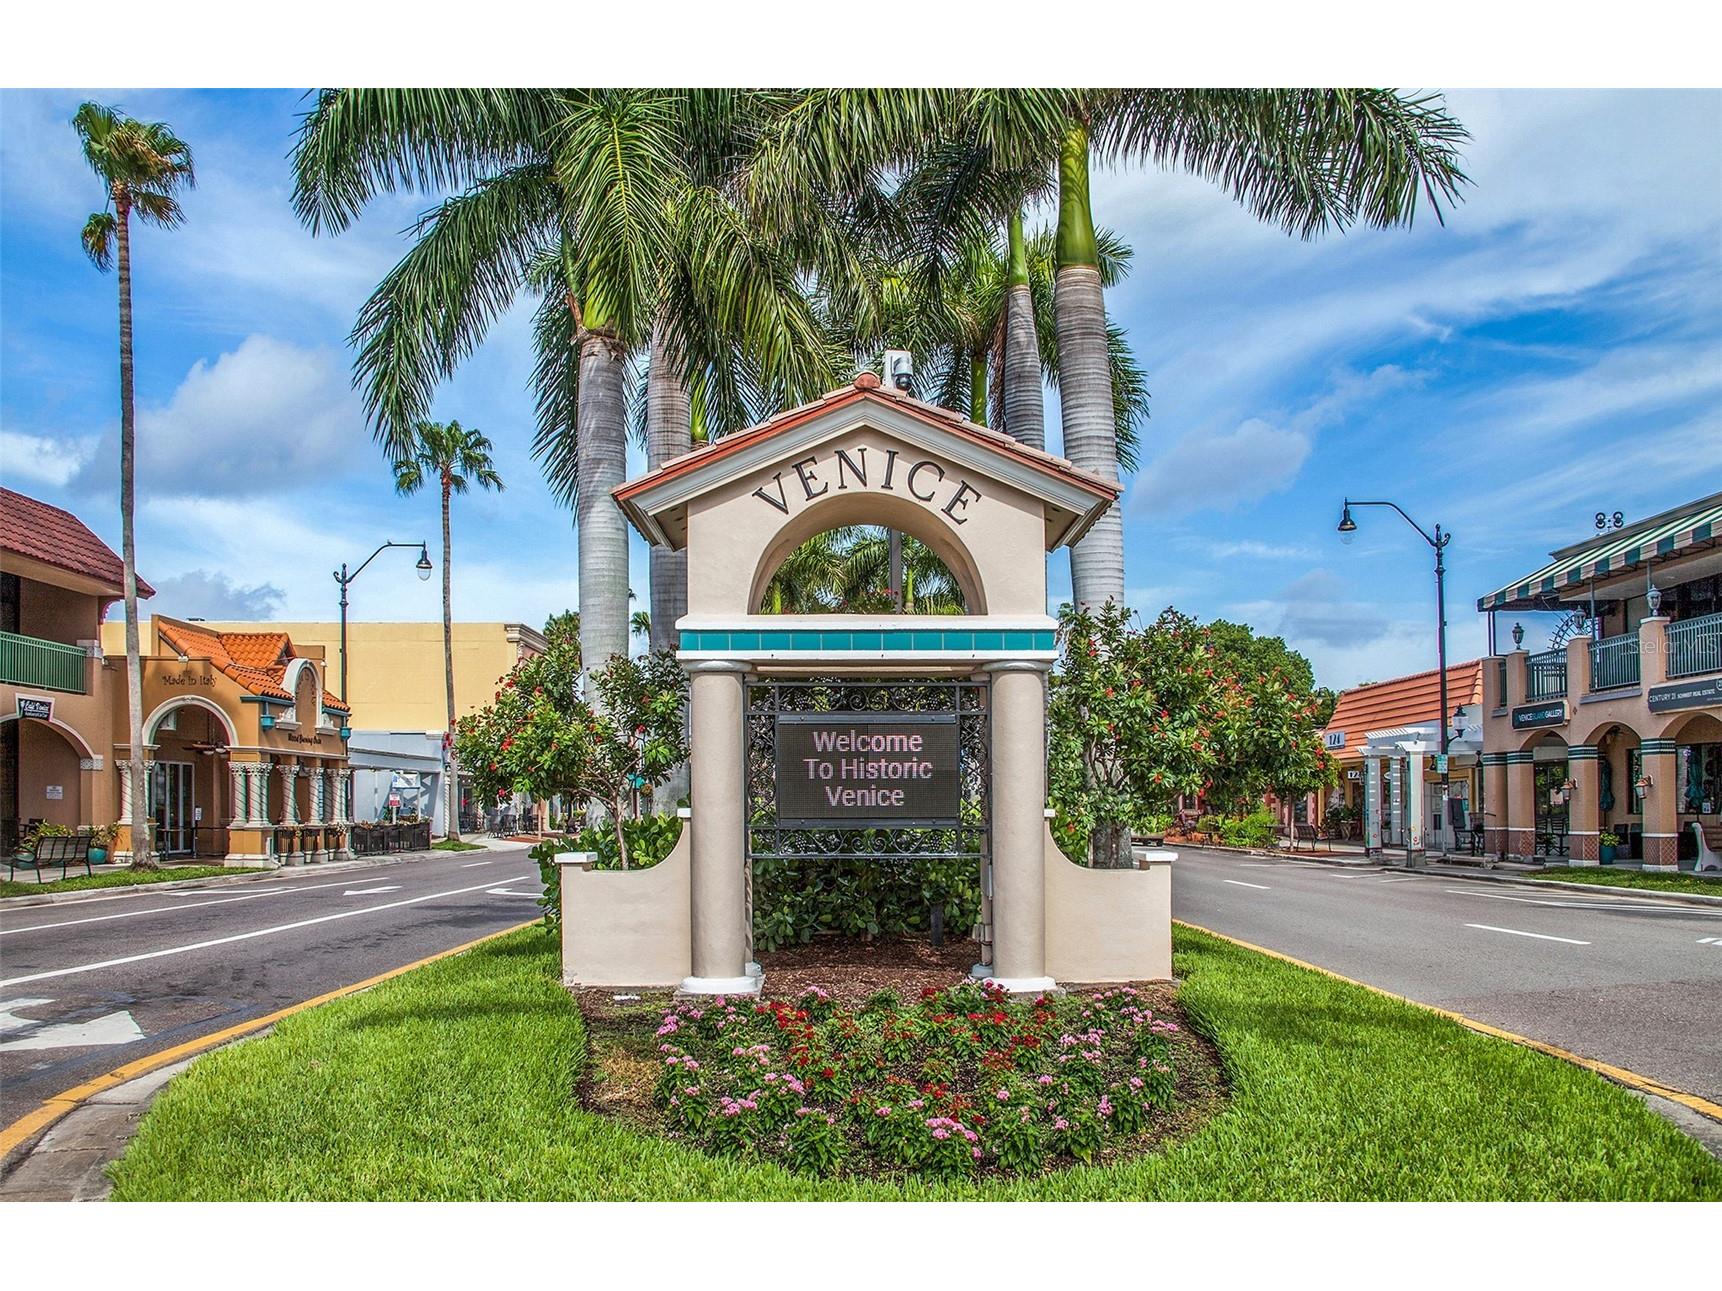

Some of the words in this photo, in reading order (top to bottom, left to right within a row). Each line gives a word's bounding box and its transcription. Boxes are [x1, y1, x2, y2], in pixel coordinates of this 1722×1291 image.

[752, 448, 981, 525] VENICE
[1649, 693, 1670, 703] CENTURY
[813, 730, 924, 753] Welcome
[803, 758, 833, 781] To
[841, 756, 933, 780] Historic
[826, 785, 905, 807] Venice
